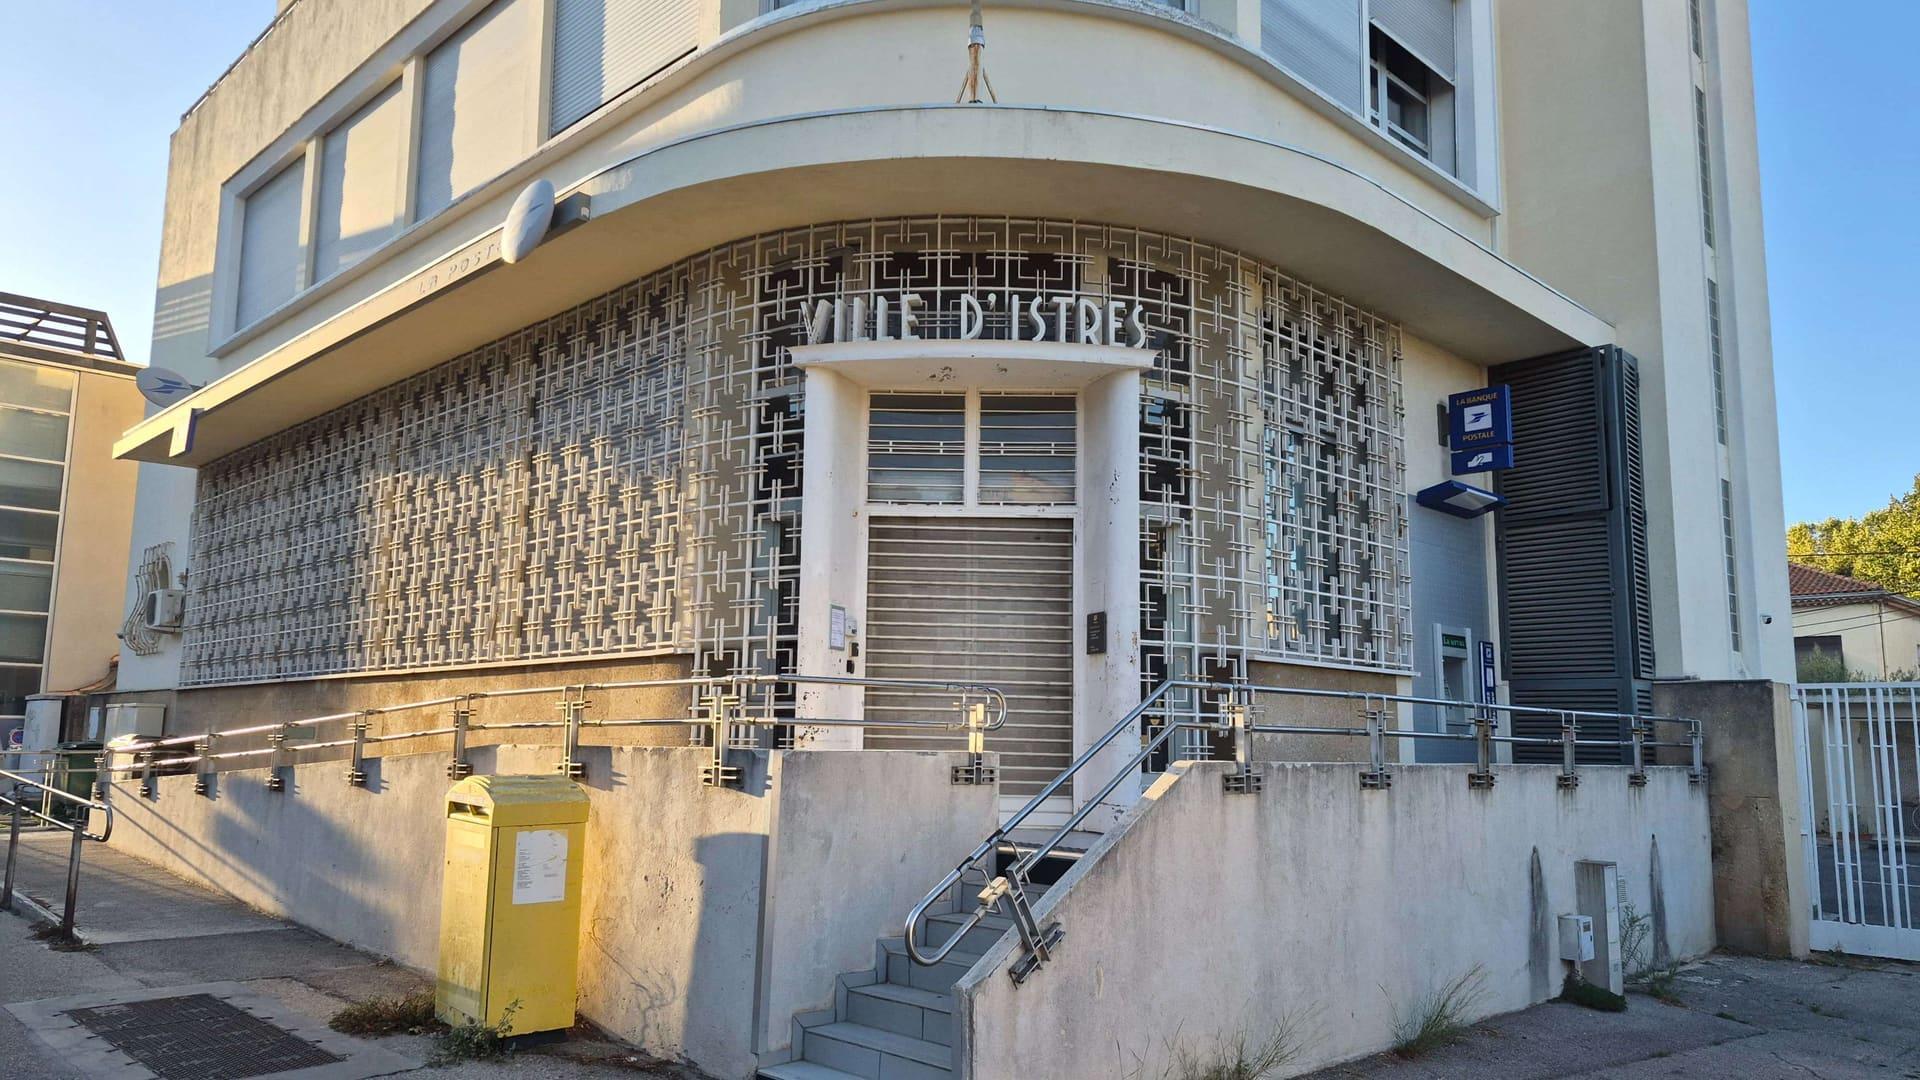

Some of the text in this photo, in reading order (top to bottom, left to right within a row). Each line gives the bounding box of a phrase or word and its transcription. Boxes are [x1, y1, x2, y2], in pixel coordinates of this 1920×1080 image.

[416, 242, 502, 295] LA POST
[800, 292, 1146, 349] VILLE D'ISTRES
[1456, 392, 1498, 406] LA BANQUE
[1462, 431, 1495, 441] POSTALE
